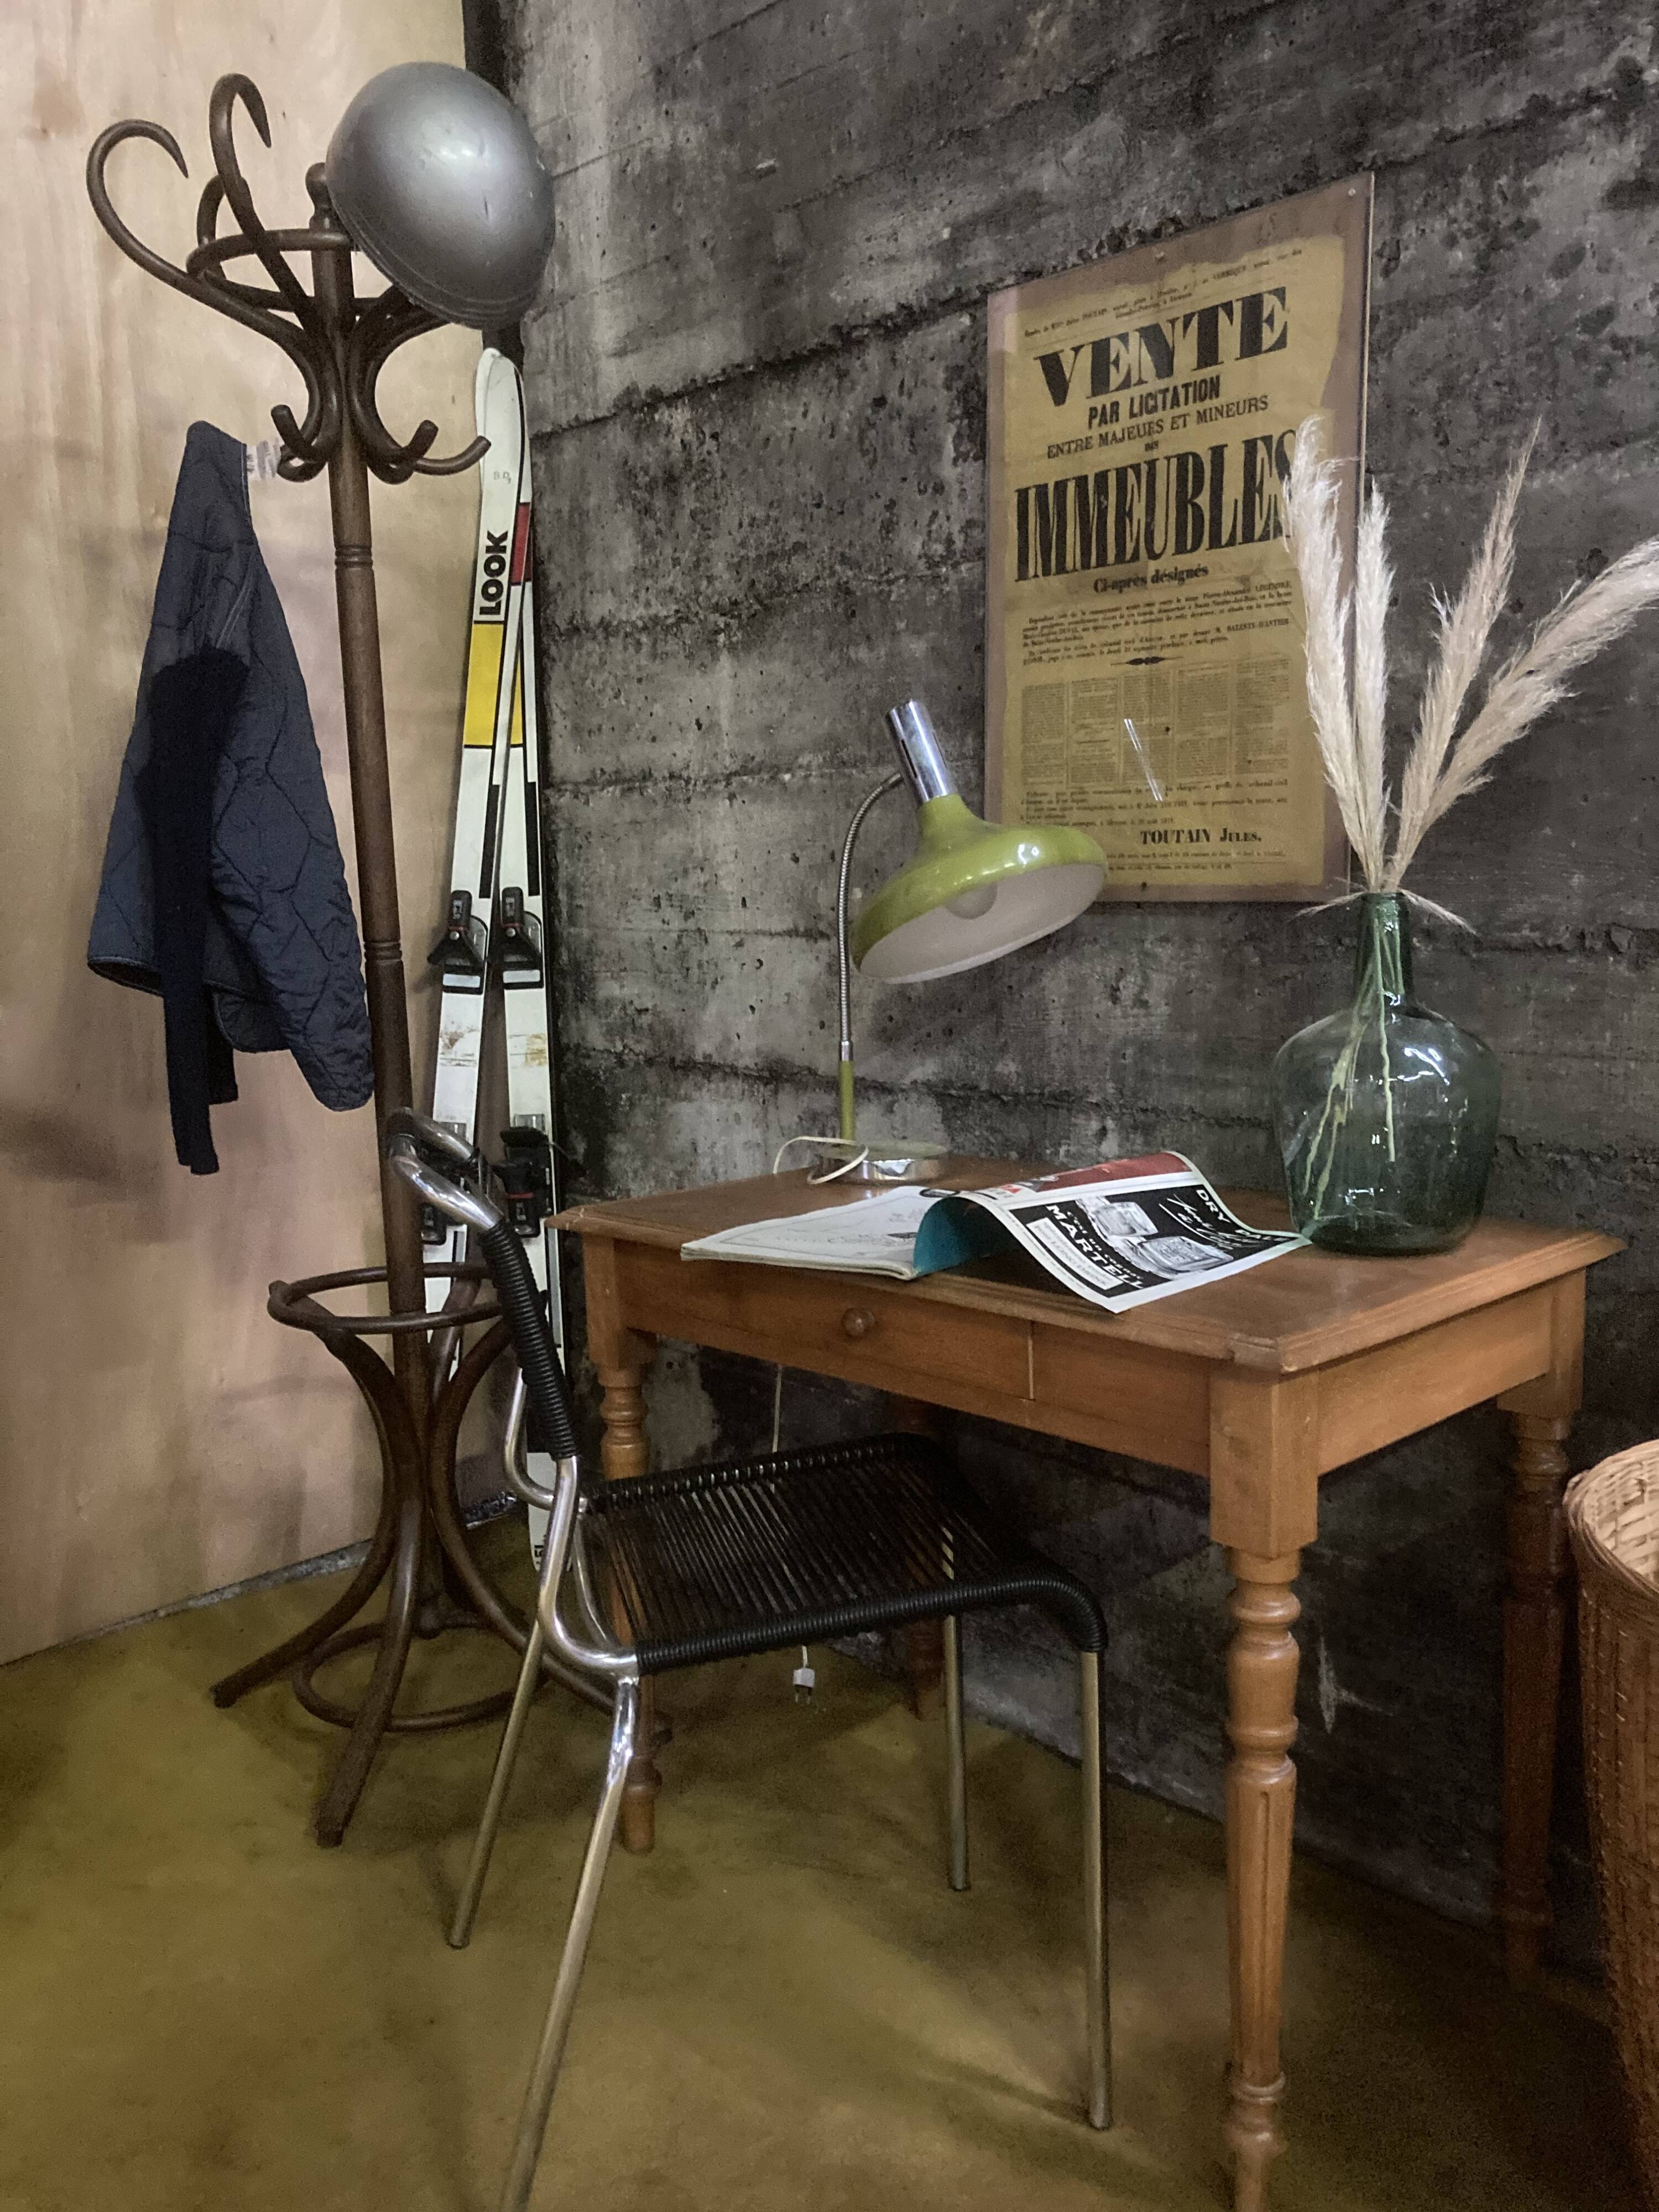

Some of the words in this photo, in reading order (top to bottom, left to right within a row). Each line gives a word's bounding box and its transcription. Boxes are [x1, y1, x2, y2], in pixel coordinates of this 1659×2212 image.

[1035, 286, 1290, 407] VENTE
[1047, 436, 1094, 460] ENTRE
[1098, 420, 1164, 447] MAJEURS
[1170, 413, 1190, 430] ET
[1197, 395, 1269, 424] MINEURS
[1088, 404, 1120, 429] PAR
[1129, 375, 1221, 420] LICITATION
[479, 530, 508, 615] LOOK
[1151, 563, 1210, 585] désignés
[1140, 828, 1211, 844] TOUTAIN
[1196, 1189, 1232, 1223] DRY
[1046, 1204, 1144, 1289] MARTELL
